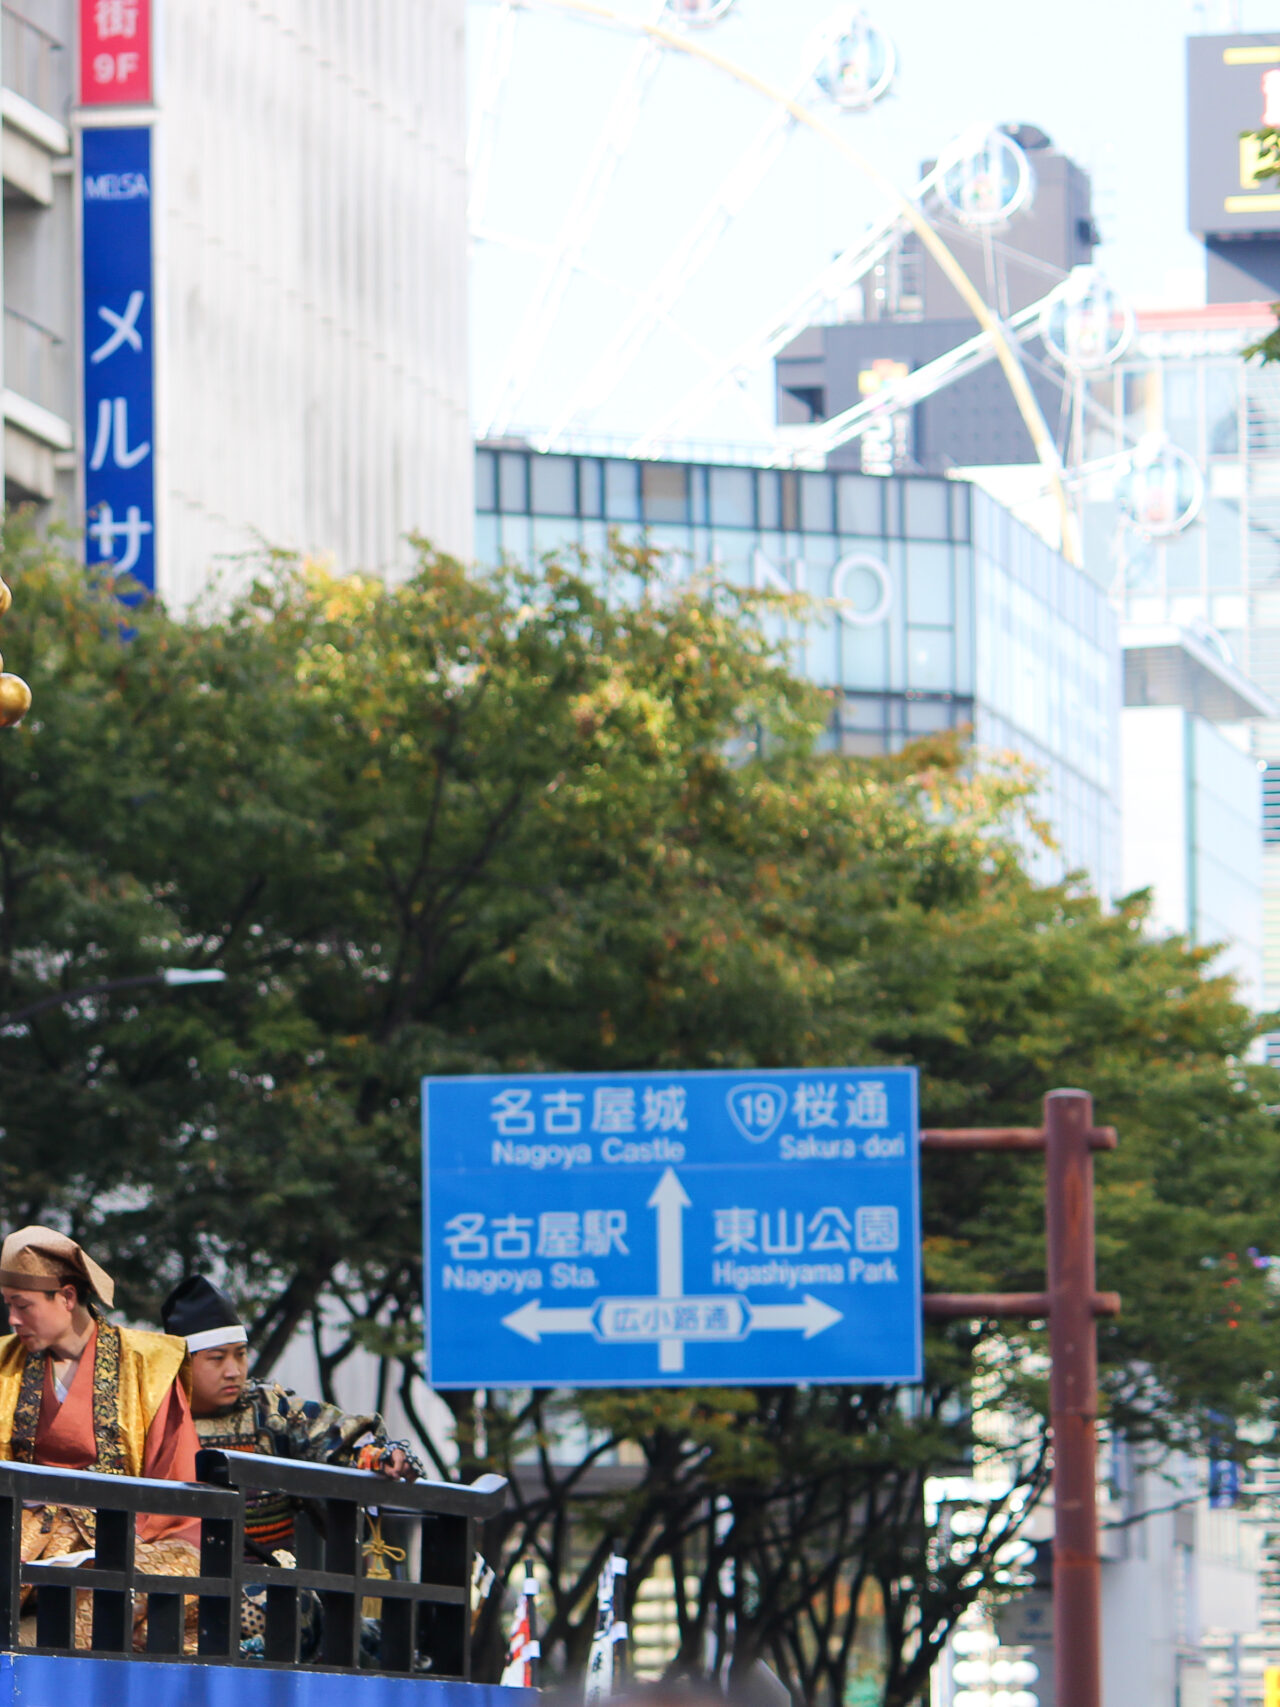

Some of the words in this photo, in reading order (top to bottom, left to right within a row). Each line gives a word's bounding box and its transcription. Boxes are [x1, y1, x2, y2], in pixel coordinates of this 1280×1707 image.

[93, 53, 139, 85] 9F
[90, 290, 152, 579] メルサ
[490, 1084, 688, 1136] 名古屋城
[741, 1093, 774, 1128] 19
[793, 1081, 889, 1129] 桜通
[492, 1141, 591, 1170] Nagoya
[601, 1136, 686, 1163] Castle
[444, 1209, 629, 1260] 名古屋駅
[713, 1205, 900, 1255] 東山公園
[443, 1265, 543, 1294] Nagoya
[551, 1262, 599, 1289] Sta.
[713, 1260, 844, 1290] Higashiyama
[849, 1257, 899, 1284] Park
[613, 1304, 730, 1333] 広小路通
